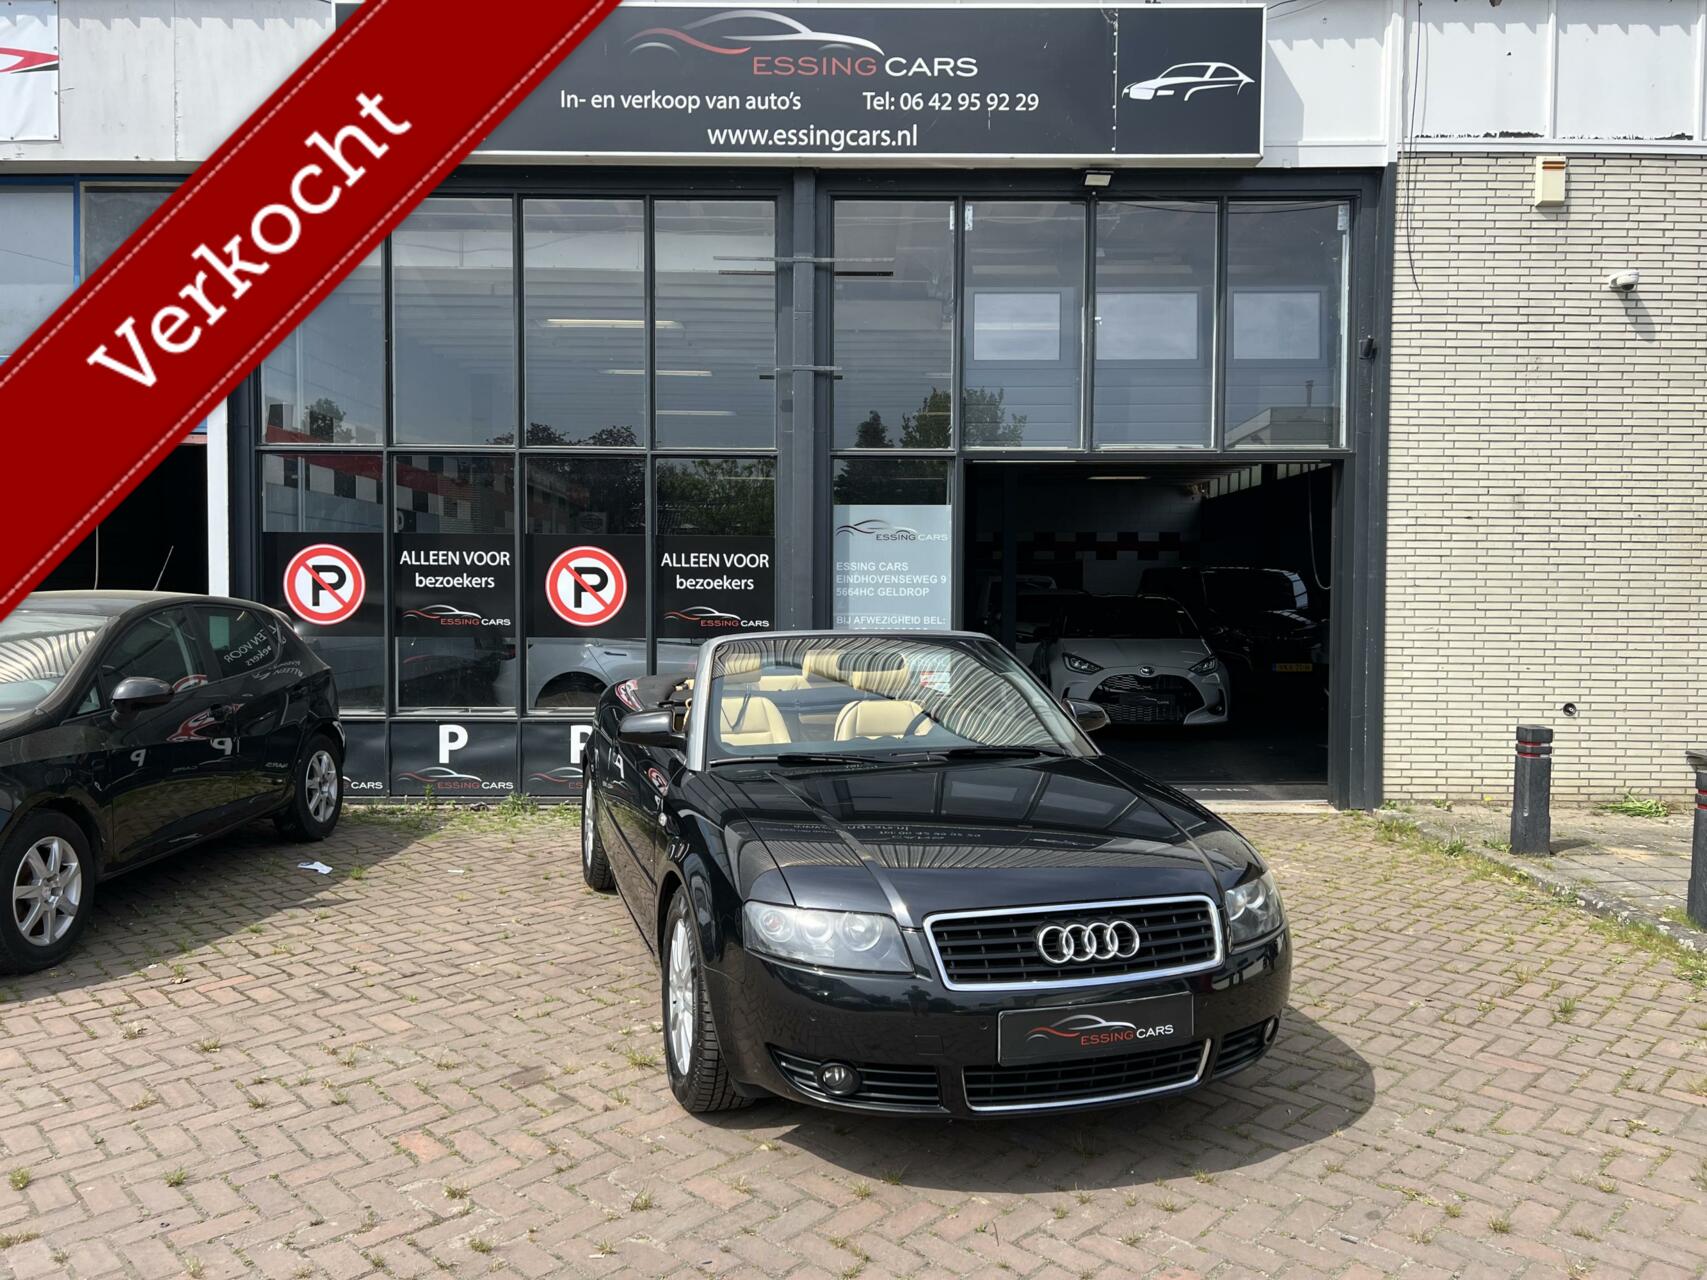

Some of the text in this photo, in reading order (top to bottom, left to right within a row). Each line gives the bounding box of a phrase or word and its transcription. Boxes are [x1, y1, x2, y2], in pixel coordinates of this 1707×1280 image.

[752, 56, 978, 77] ESSING CARS
[560, 90, 586, 109] In-
[591, 94, 615, 109] en
[620, 90, 700, 114] verkoop
[705, 95, 740, 110] van
[862, 91, 1039, 112] Tel: 06 42 95 92 29
[707, 124, 918, 151] www.essingcars.nl
[876, 533, 948, 541] ESSING CARS
[400, 550, 510, 566] ALLEEN VOOR
[661, 552, 769, 568] ALLEEN VOOR
[836, 562, 909, 571] ESSING CARS
[311, 565, 346, 606] P
[415, 572, 495, 588] bezoekers
[574, 566, 608, 608] P
[676, 574, 754, 590] bezoekers
[836, 575, 947, 584] EINDHOVENSEWEG 9
[836, 587, 930, 597] 5664HC GELDROP
[481, 618, 511, 626] CARS
[836, 616, 946, 625] BIJ AFWEZIGHEID BEL:
[439, 724, 468, 763] P
[570, 725, 593, 763] P
[350, 781, 383, 789] CARS
[481, 781, 514, 789] CARS
[1081, 1024, 1174, 1046] ESSING CARS
